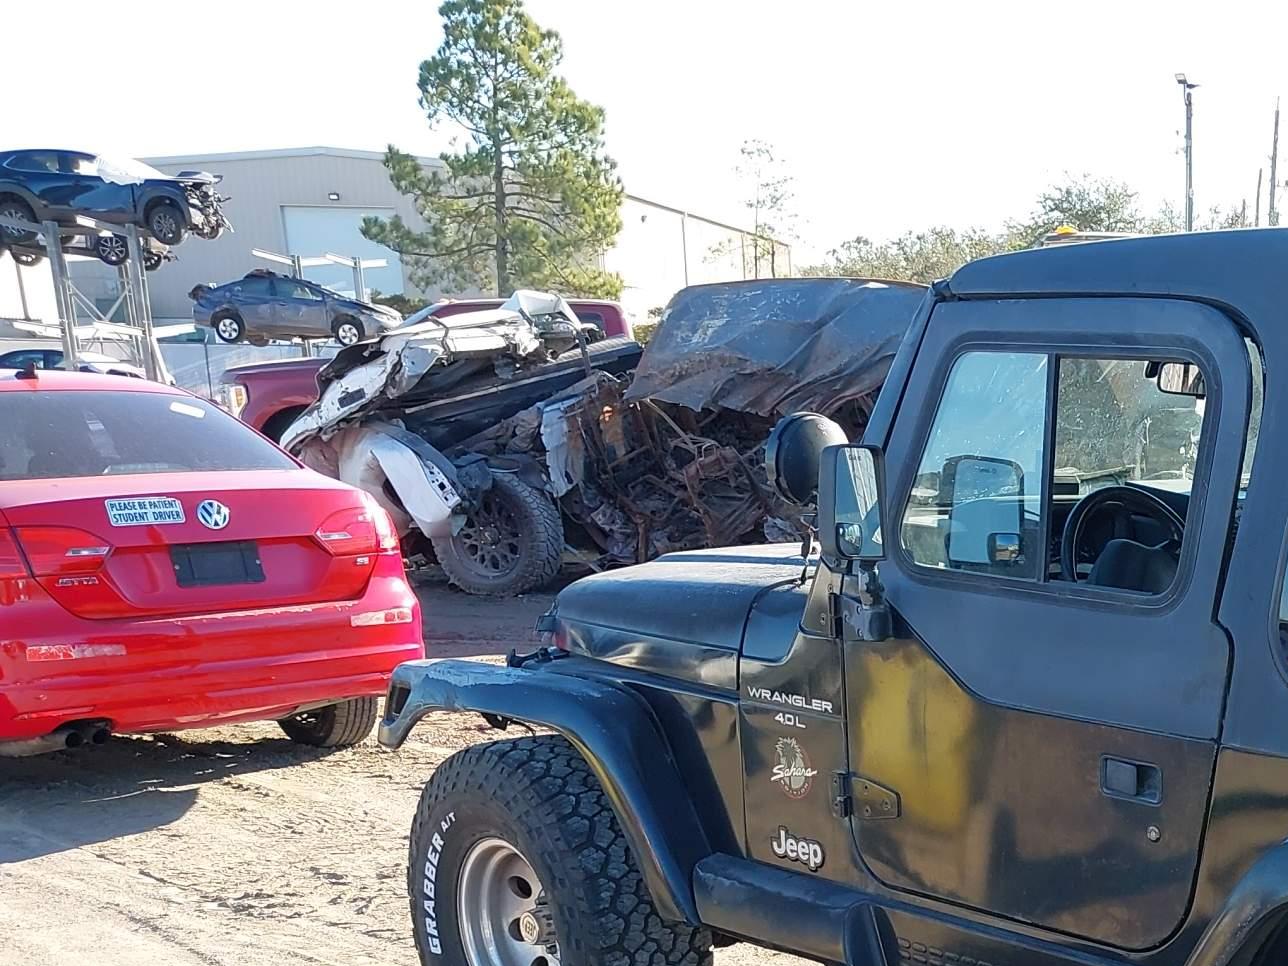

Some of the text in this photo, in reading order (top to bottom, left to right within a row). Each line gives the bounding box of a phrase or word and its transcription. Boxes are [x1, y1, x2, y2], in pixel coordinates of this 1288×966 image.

[109, 499, 178, 512] PLEASE BE PATIENT
[112, 510, 182, 524] STUDENT DRIVER
[747, 686, 833, 713] WRANGLER
[770, 762, 818, 781] Sahara
[771, 828, 823, 871] Jeep
[423, 811, 457, 956] GRABBER A/T
